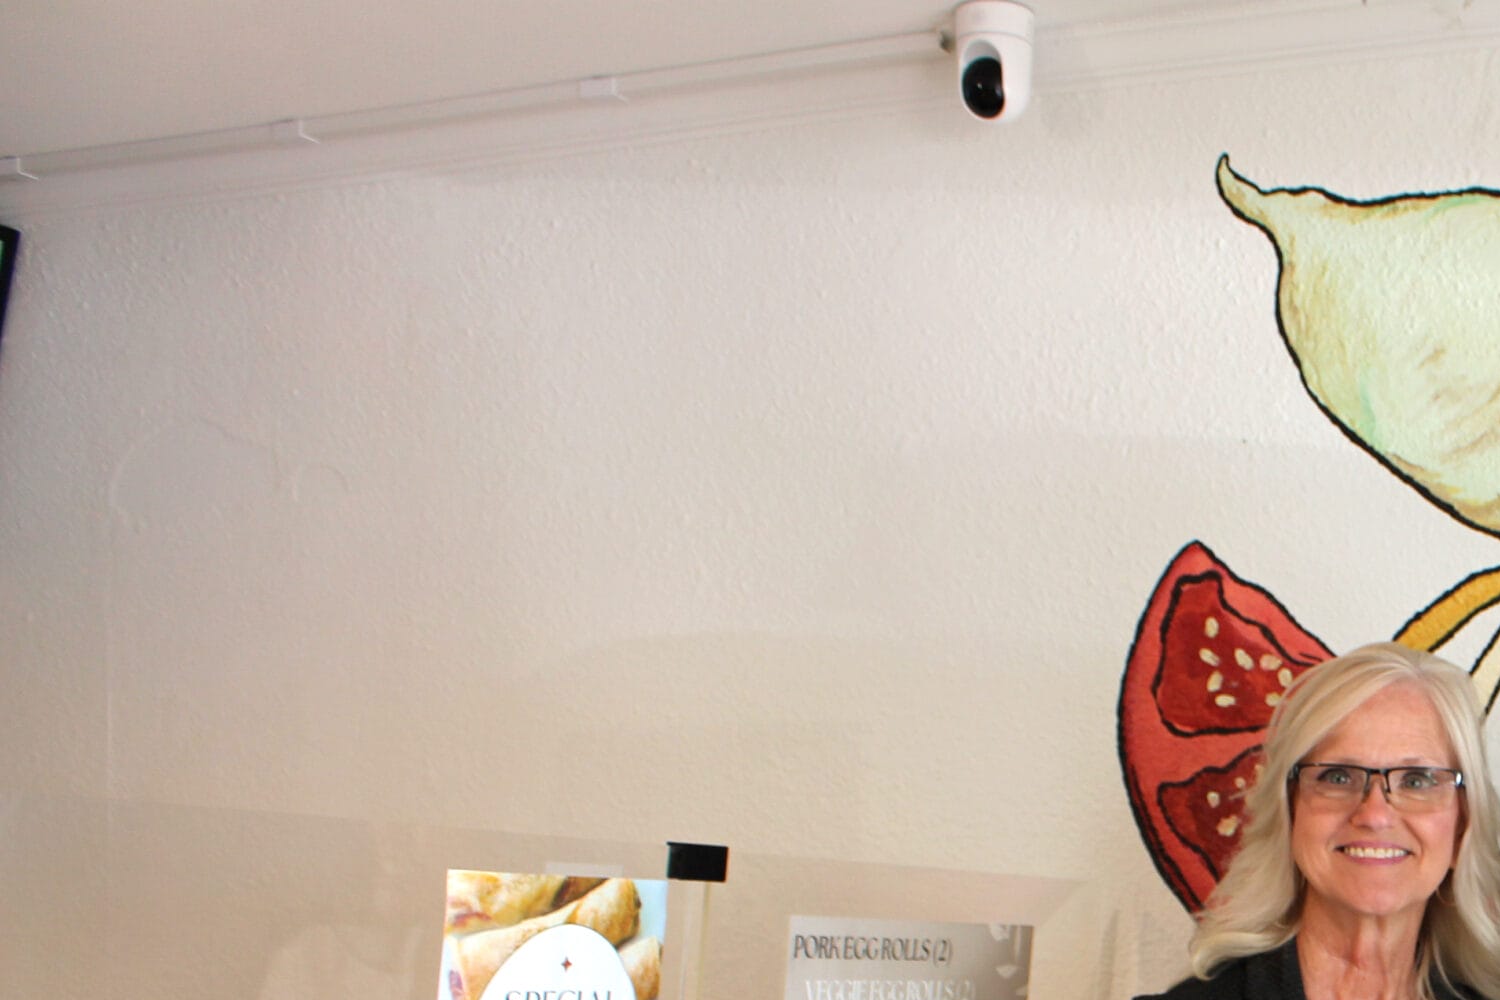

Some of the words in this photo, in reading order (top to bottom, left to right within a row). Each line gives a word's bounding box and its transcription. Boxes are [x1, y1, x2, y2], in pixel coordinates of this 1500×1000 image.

[794, 934, 841, 960] PORK
[844, 936, 878, 961] EGG
[880, 937, 930, 962] ROLLS
[932, 938, 953, 967] (2)
